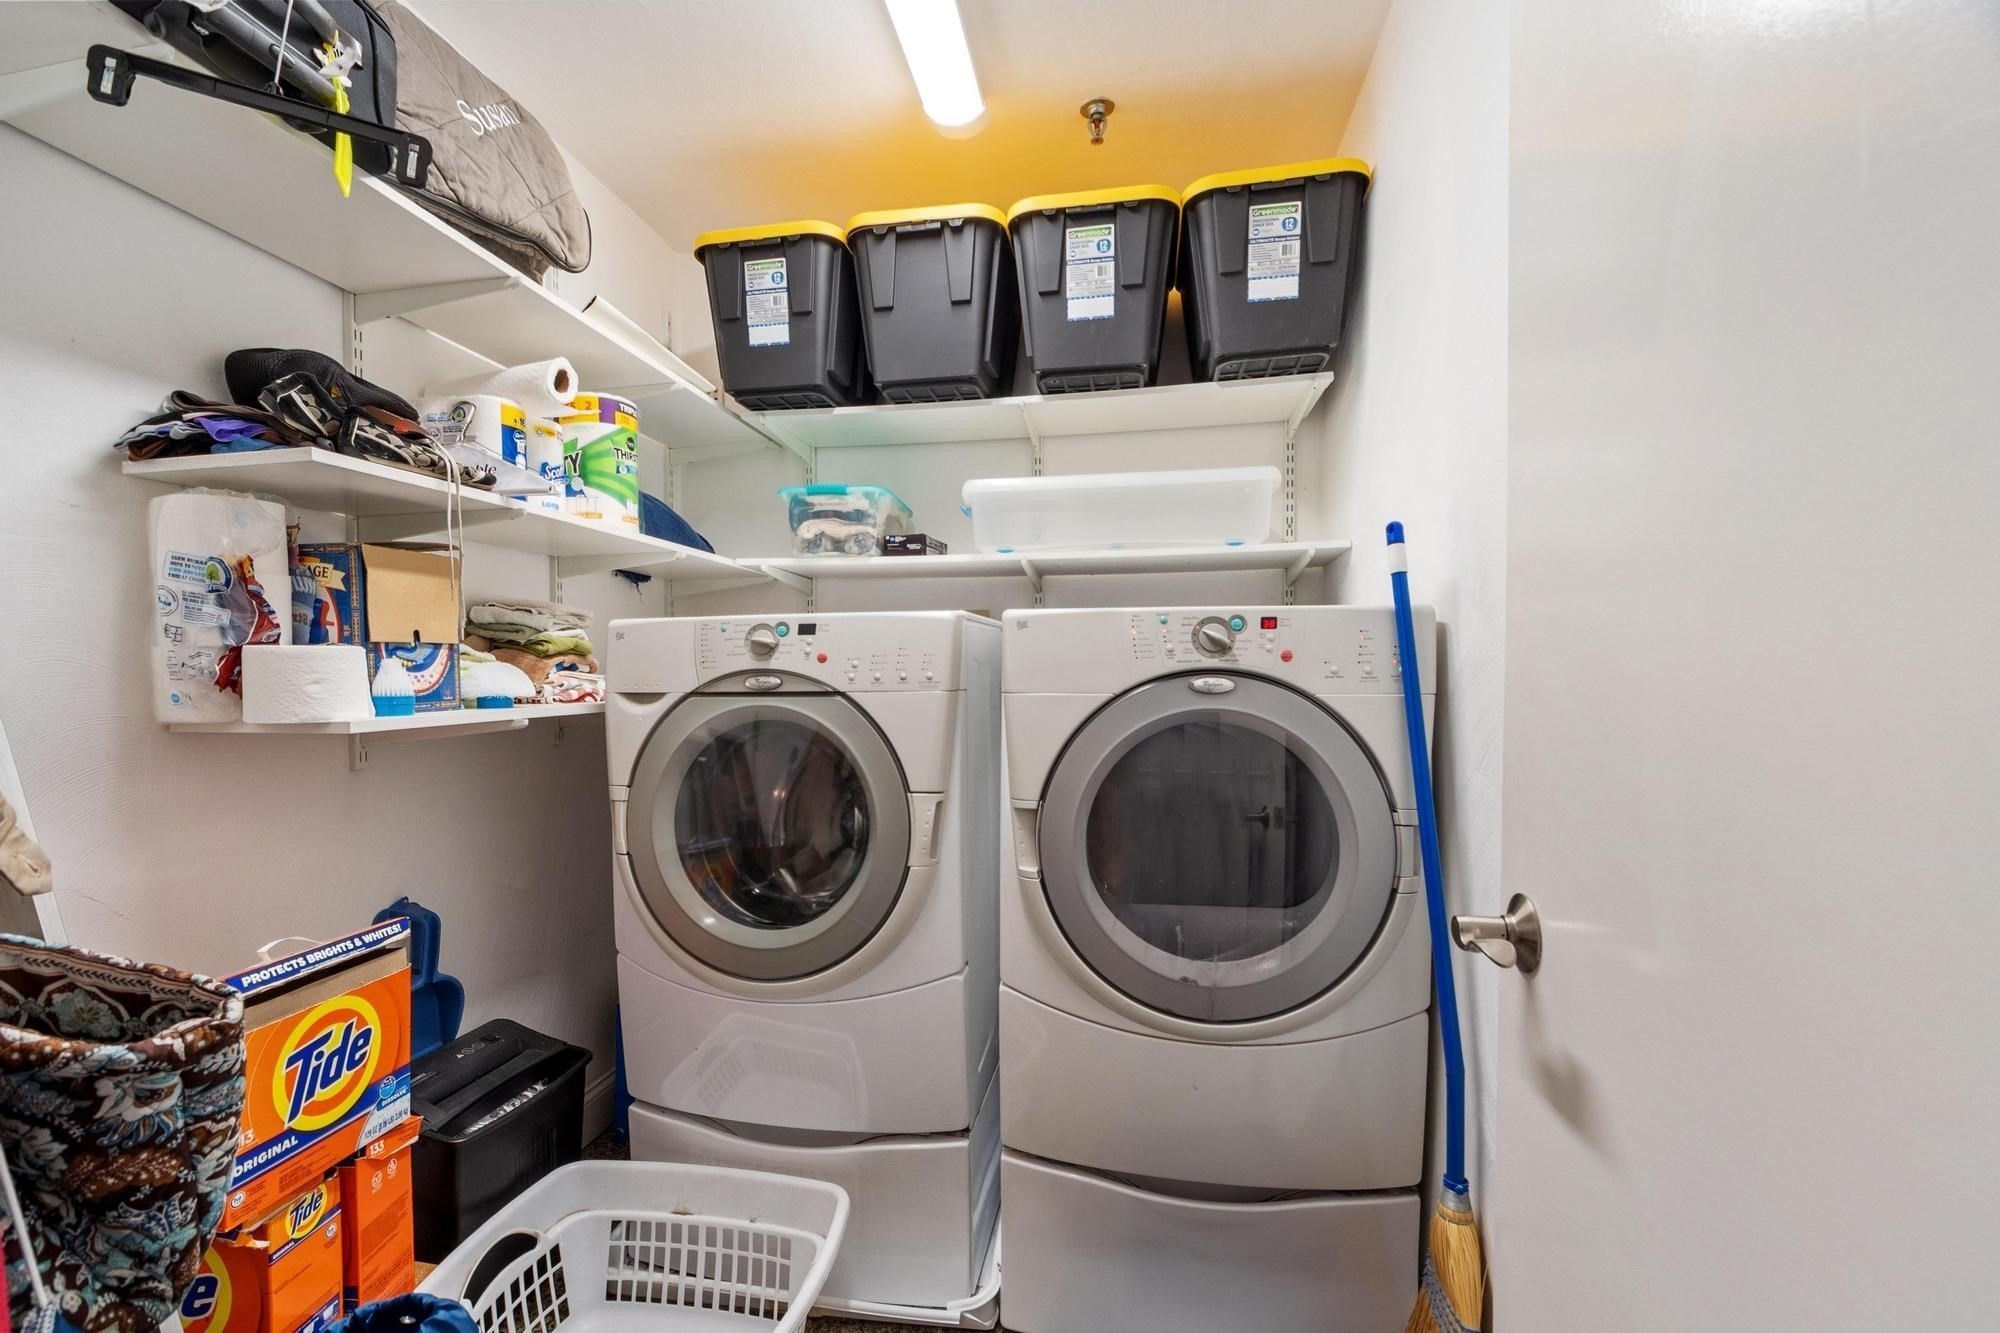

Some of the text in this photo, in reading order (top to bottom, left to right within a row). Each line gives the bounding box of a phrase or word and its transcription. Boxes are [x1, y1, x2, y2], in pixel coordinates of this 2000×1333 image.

[456, 99, 520, 136] Susan
[1286, 218, 1295, 227] 12
[1100, 241, 1108, 250] 12
[774, 273, 781, 281] 12
[241, 923, 402, 987] PROTECTS BRIGHTS & WHITES!
[282, 1016, 374, 1128] Tide
[231, 1135, 299, 1177] ORIGINAL
[370, 1139, 385, 1155] 133
[289, 1190, 324, 1237] Tide
